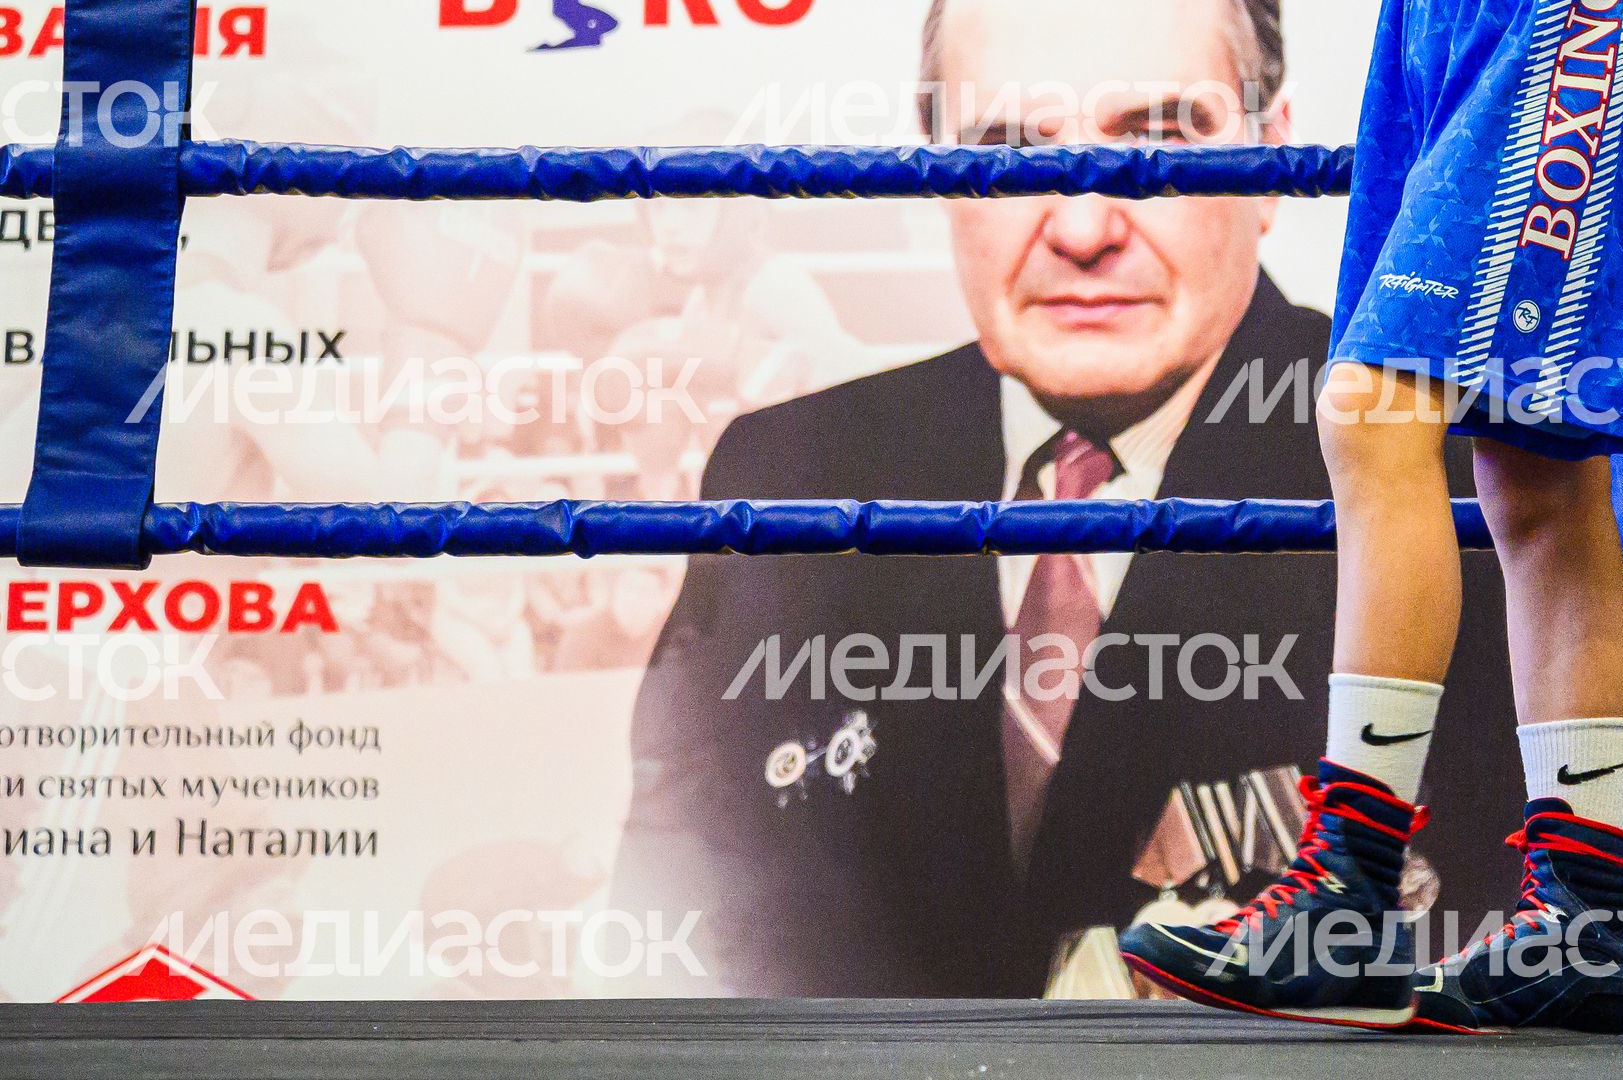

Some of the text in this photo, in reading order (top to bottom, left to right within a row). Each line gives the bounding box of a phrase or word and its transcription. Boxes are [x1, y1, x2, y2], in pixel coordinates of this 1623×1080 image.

[2, 580, 341, 633] ЕРХОВА
[289, 719, 382, 754] фонд
[38, 775, 168, 799] святых
[182, 775, 380, 807] мучеников
[4, 817, 378, 857] иана и Наталии
